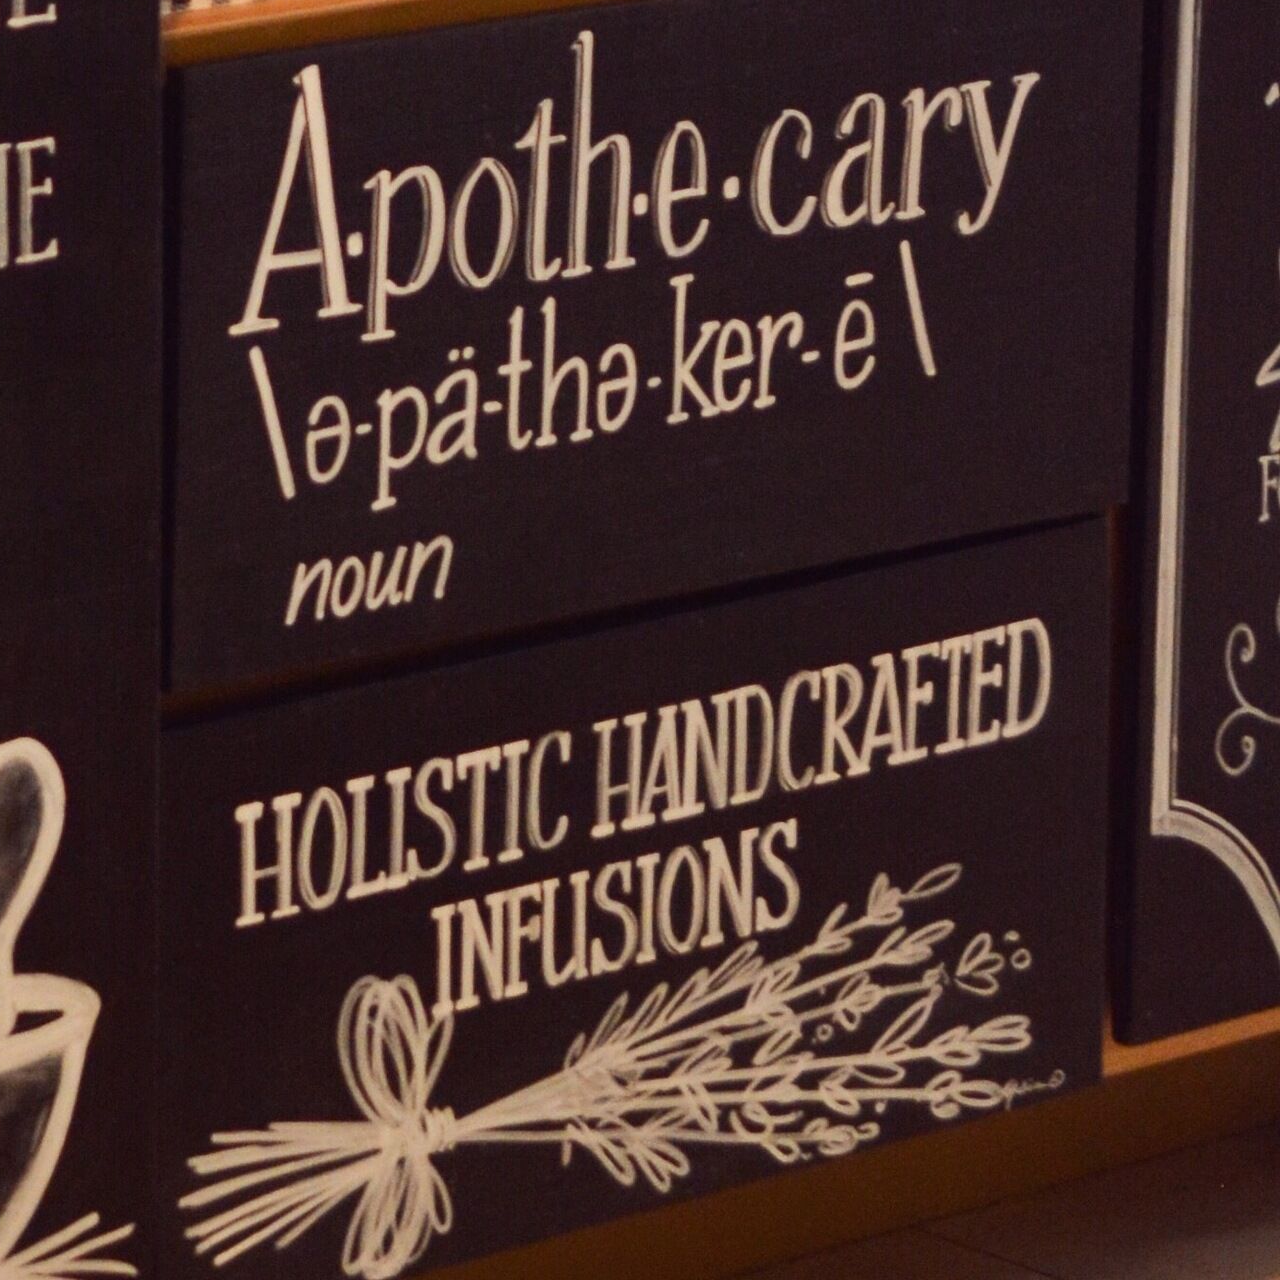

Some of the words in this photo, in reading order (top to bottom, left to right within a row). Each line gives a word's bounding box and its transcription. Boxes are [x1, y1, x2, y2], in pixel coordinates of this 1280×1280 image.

[283, 533, 455, 628] noun
[233, 729, 573, 929] HOLISTIC
[589, 616, 1053, 840] HANDCRAFTED
[428, 816, 801, 1020] INFUSIONS
